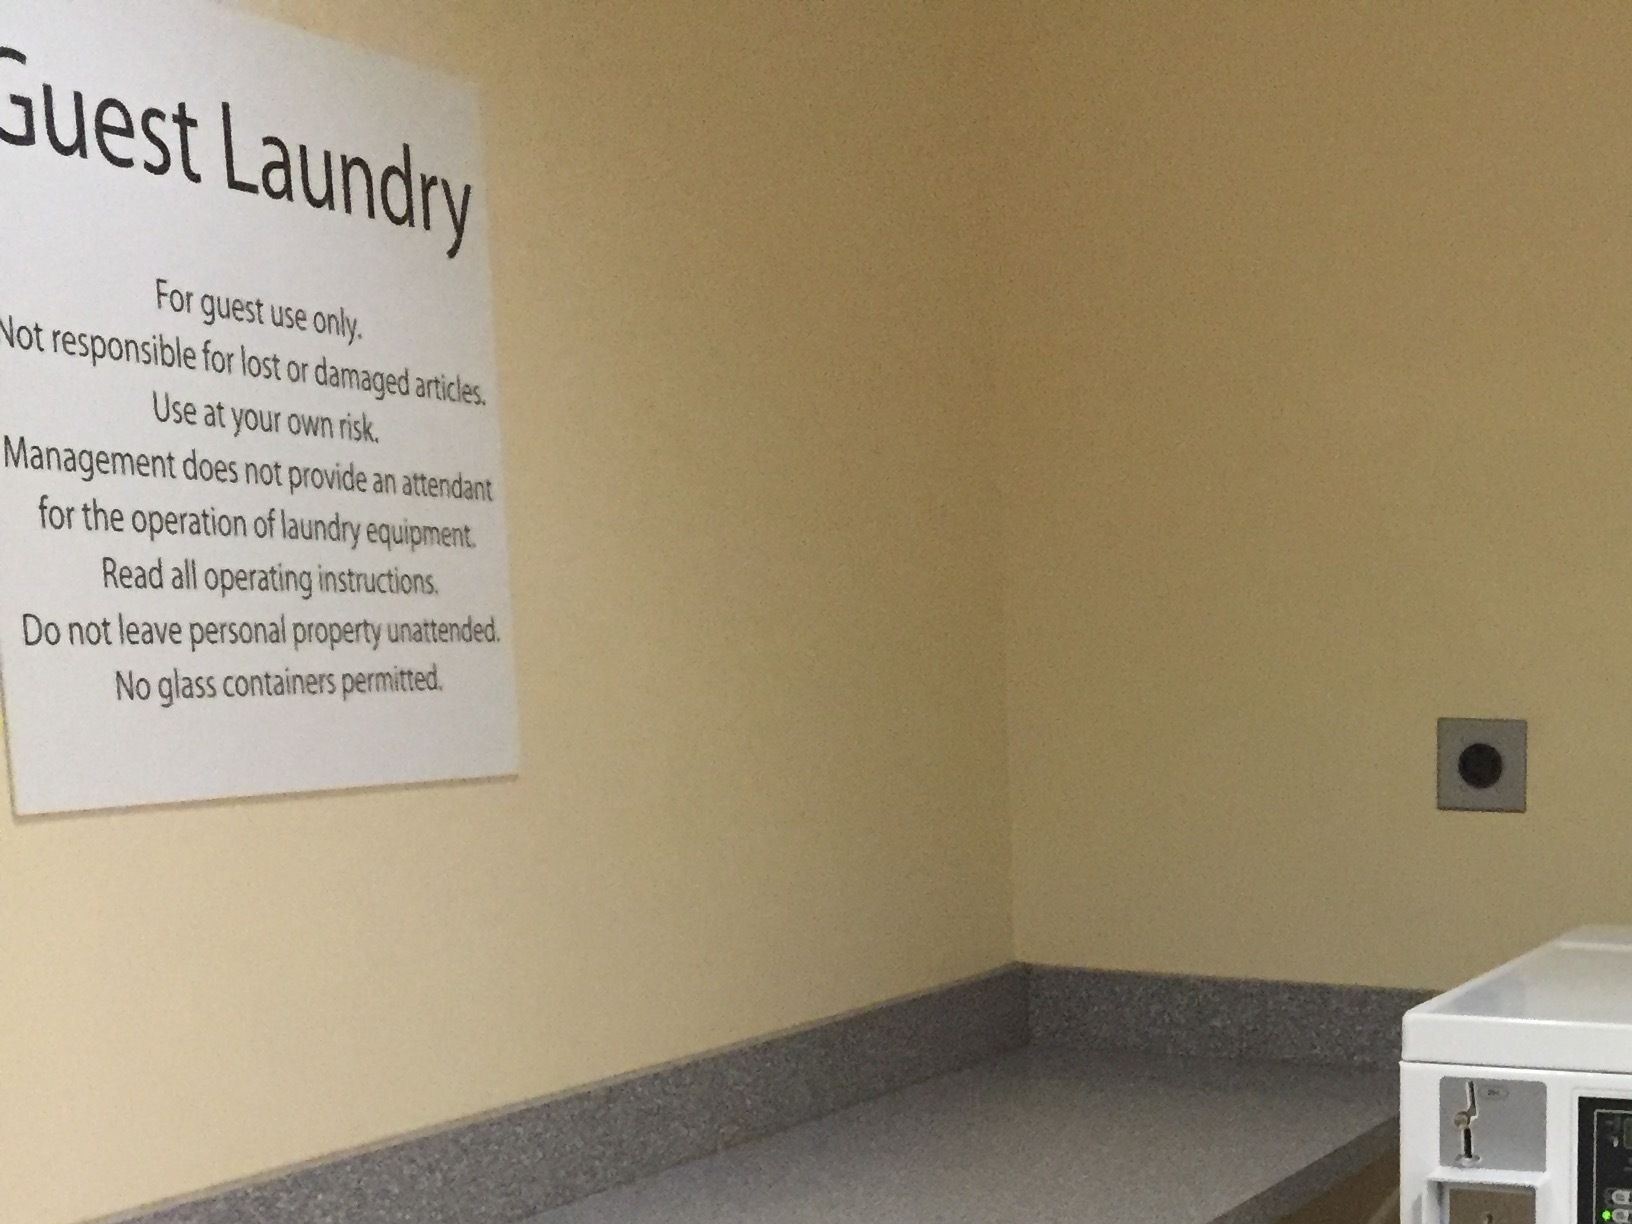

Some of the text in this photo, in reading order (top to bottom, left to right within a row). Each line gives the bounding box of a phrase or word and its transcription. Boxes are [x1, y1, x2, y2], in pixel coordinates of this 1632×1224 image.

[0, 46, 471, 258] Guest Laundry
[156, 279, 363, 345] For guest use only.
[52, 327, 196, 370] responsible
[202, 340, 234, 375] for
[241, 344, 280, 380] lost
[286, 356, 309, 383] or
[315, 357, 410, 401] damaged
[415, 373, 486, 406] articles.
[152, 391, 379, 444] Use at your own risk.
[3, 435, 494, 502] Management does not provide an attendant
[38, 494, 476, 552] for the operation of laundry equipment.
[102, 556, 439, 599] Read all operating instructions.
[22, 613, 500, 652] Do not leave personal property unattended.
[115, 663, 443, 708] No glass containers permitted.
